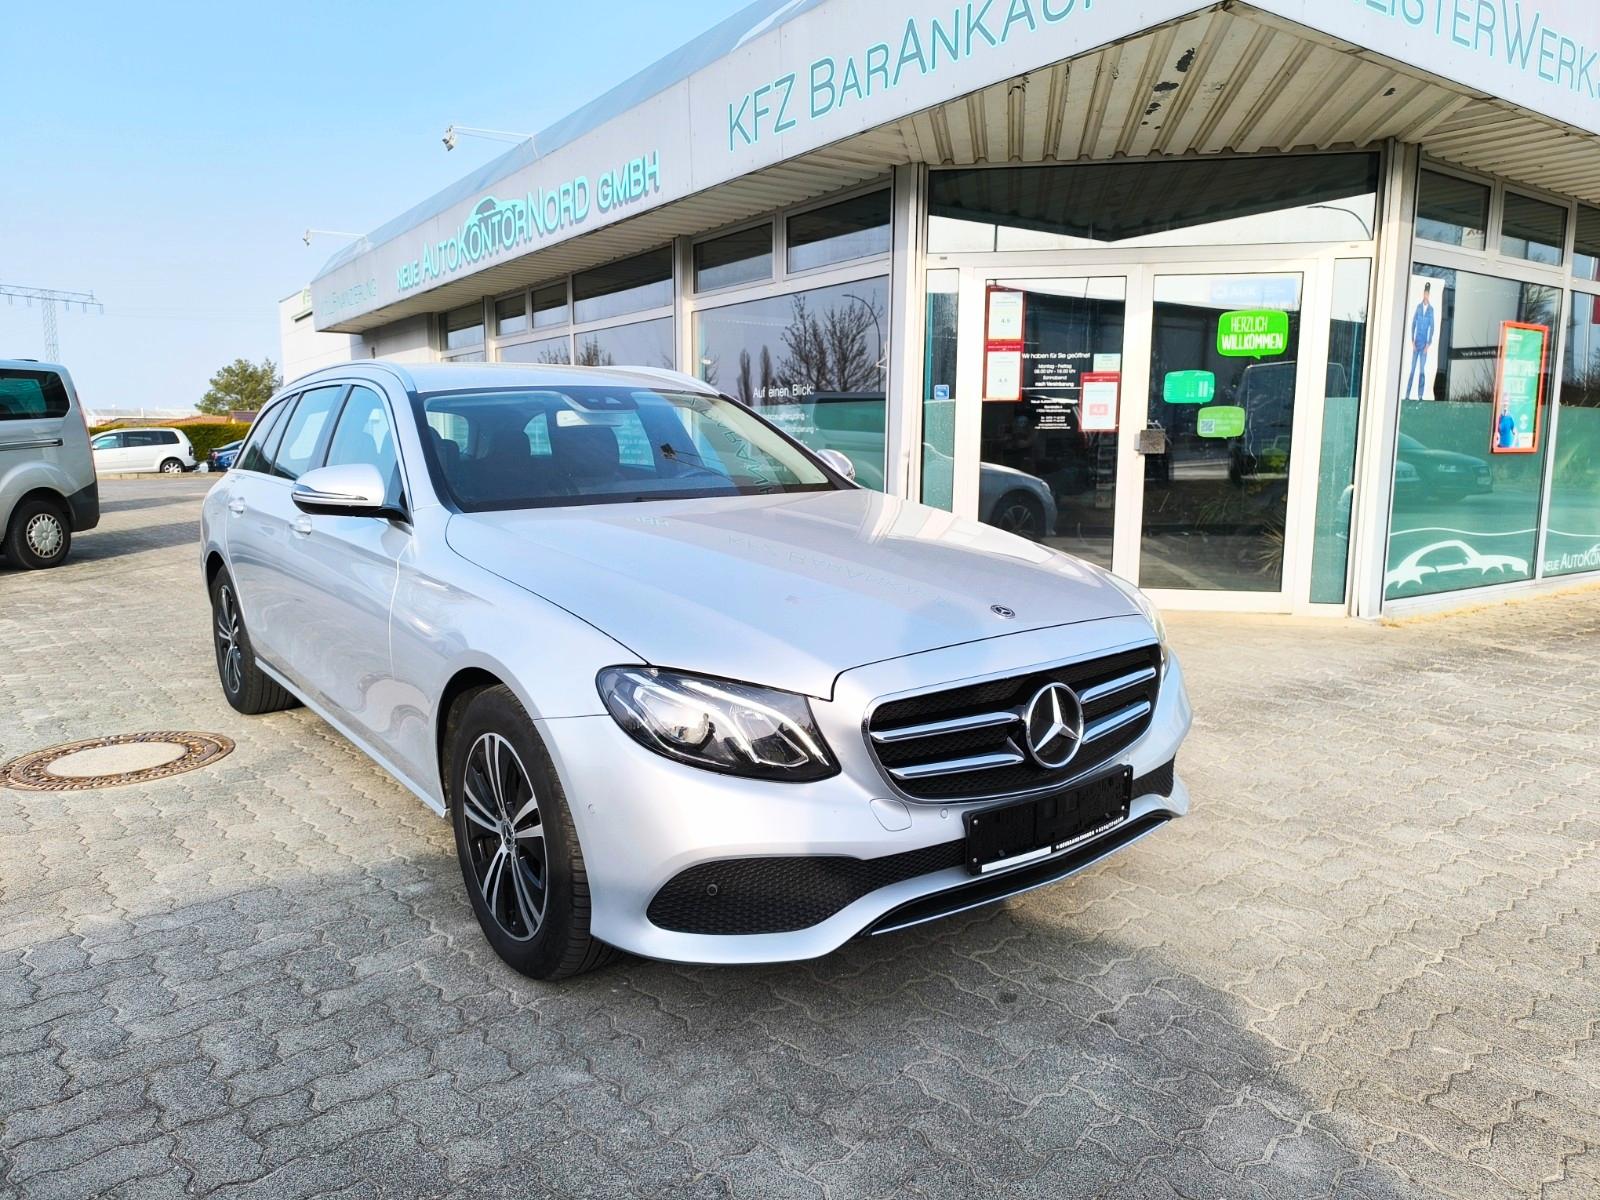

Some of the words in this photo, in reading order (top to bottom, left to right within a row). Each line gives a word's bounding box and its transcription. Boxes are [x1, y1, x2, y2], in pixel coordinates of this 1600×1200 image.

[729, 73, 796, 151] KFZ
[396, 259, 420, 290] NEUE
[597, 149, 660, 213] GMBH
[1231, 316, 1268, 333] HERZLICH
[1221, 333, 1284, 350] WILLKOMMEN
[752, 386, 766, 399] Auf
[768, 386, 790, 398] einen
[792, 383, 815, 396] Blick:
